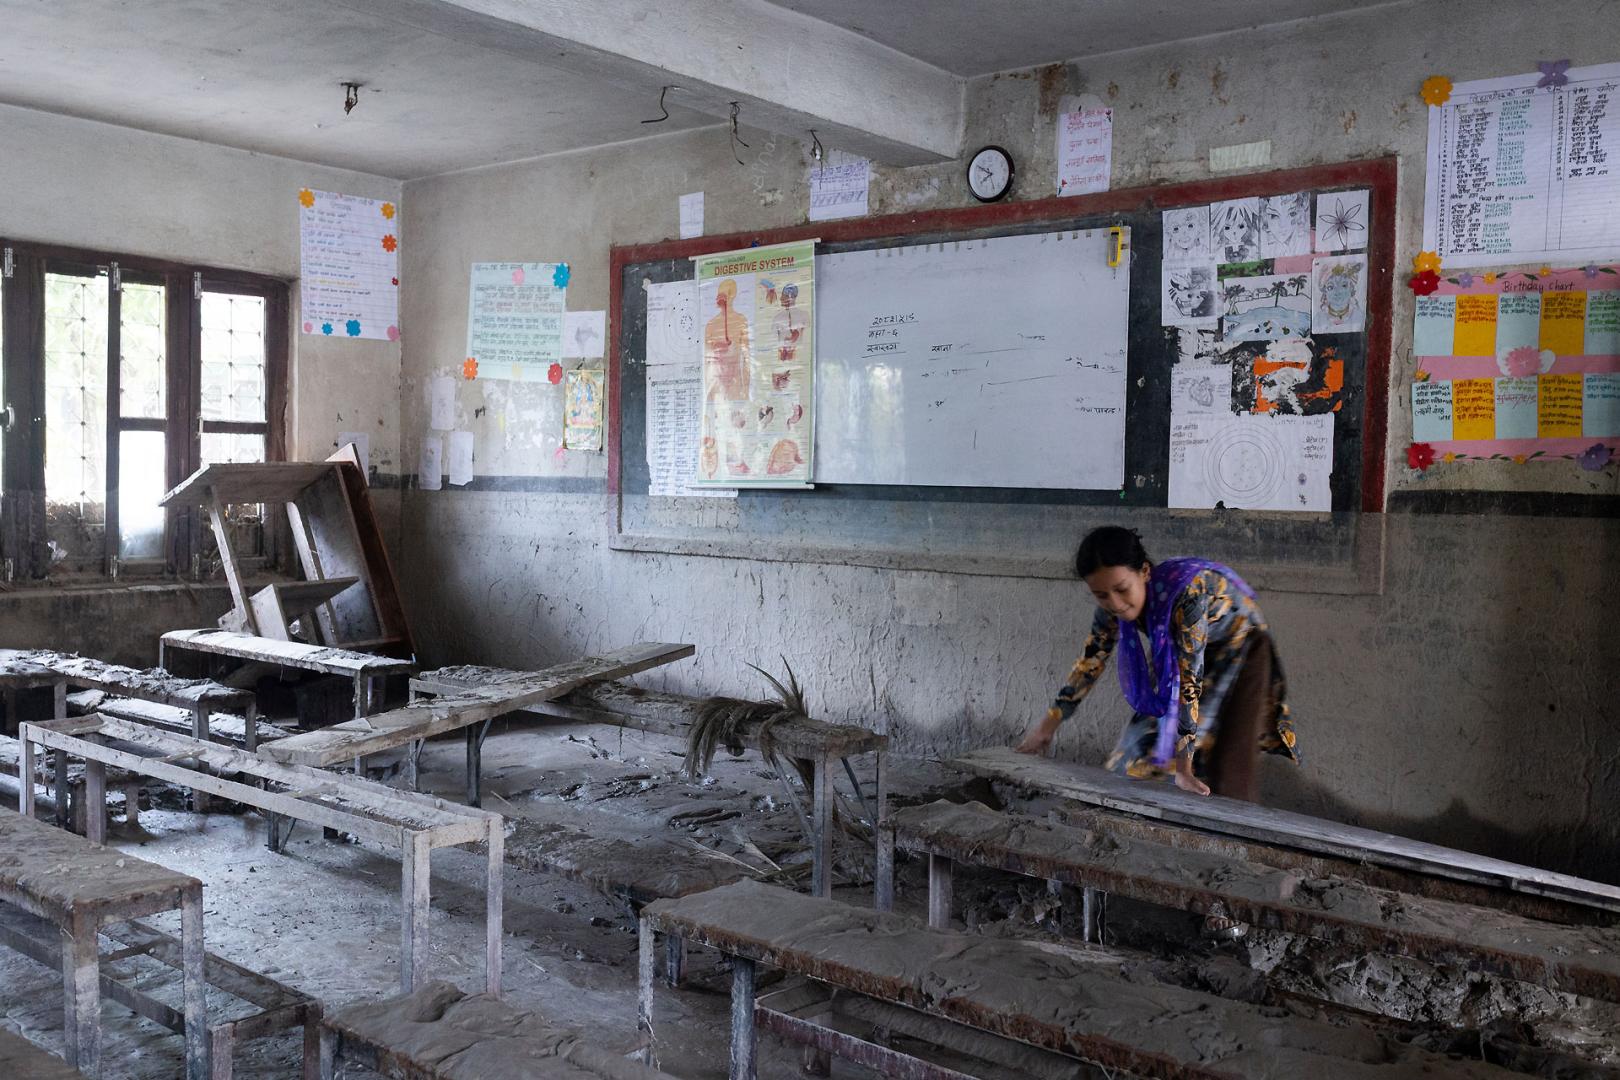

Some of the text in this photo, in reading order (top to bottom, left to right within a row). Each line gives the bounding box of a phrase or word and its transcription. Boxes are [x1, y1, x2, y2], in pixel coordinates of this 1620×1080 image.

[715, 261, 757, 276] DIGESTIVE
[759, 256, 794, 270] SYSTEM
[1504, 280, 1544, 294] Birthday
